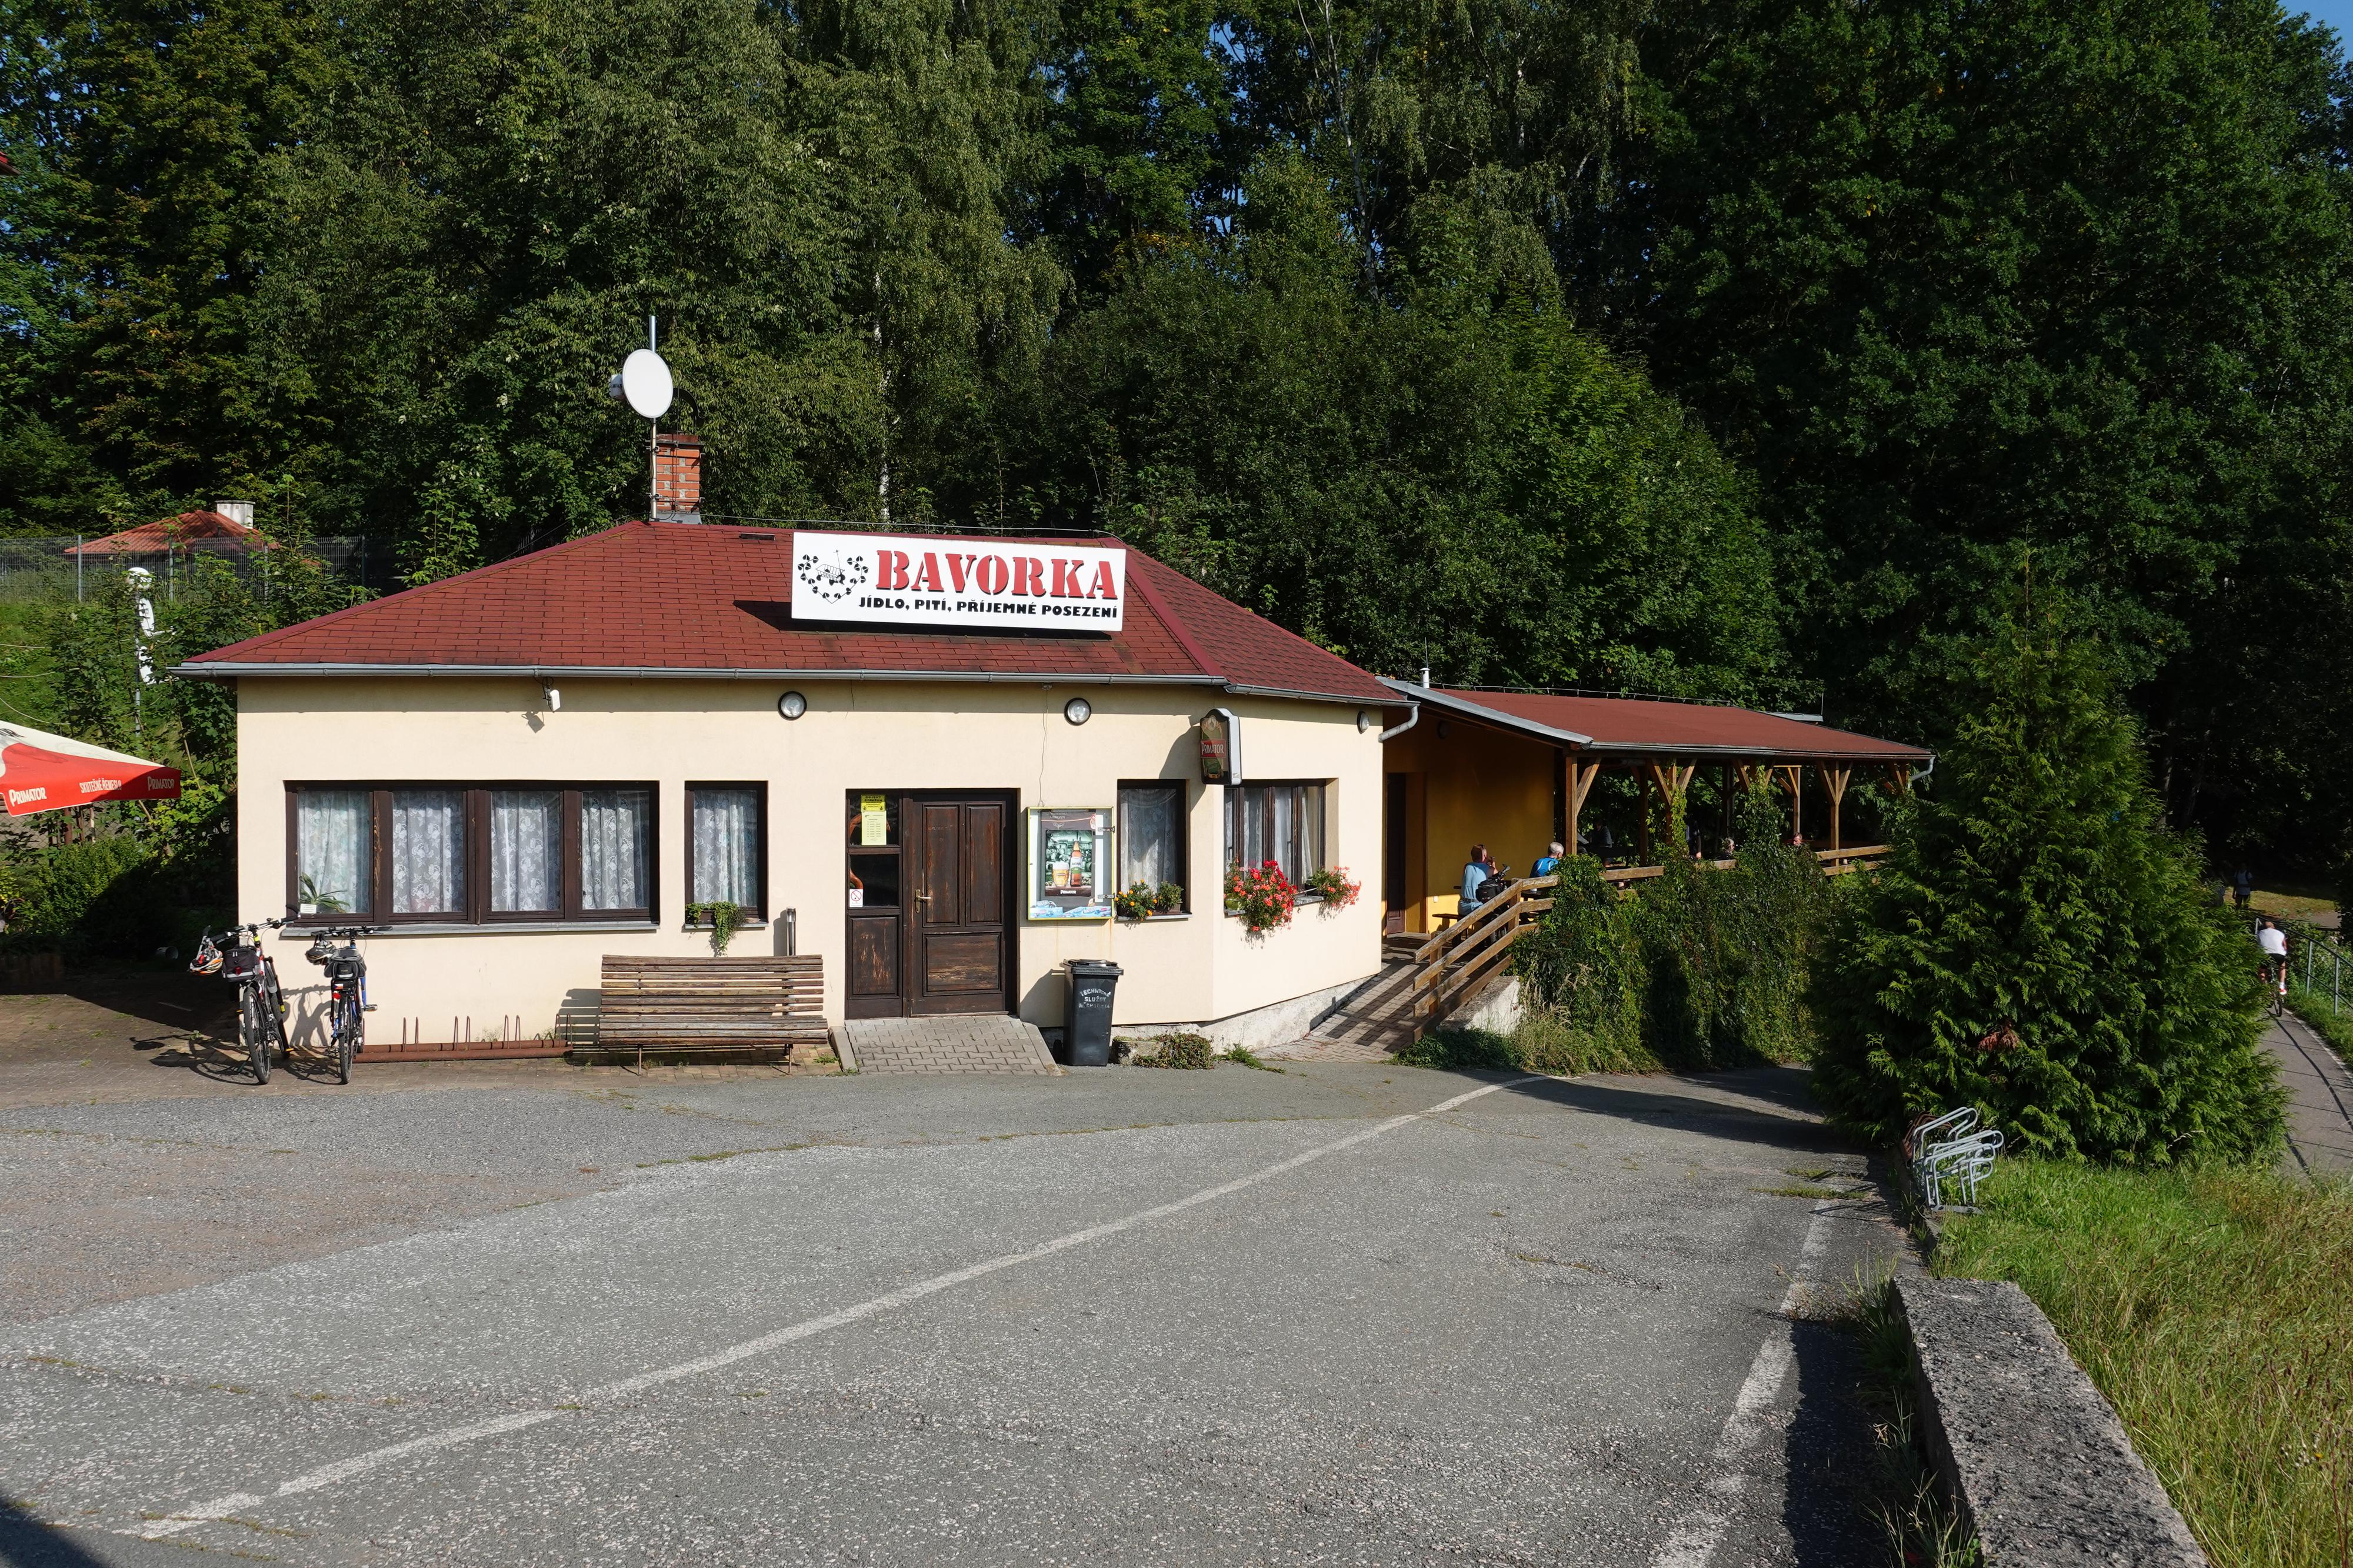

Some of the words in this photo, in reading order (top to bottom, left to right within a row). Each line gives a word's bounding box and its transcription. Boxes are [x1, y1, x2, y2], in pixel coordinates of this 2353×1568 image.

[875, 549, 1118, 600] BAVORKA
[859, 595, 909, 611] JÍDLO,
[915, 598, 952, 612] PITÍ,
[956, 599, 1036, 615] PŘÍJEMNÉ
[1041, 605, 1118, 618] POSEZENÍ
[1201, 742, 1224, 755] PRIMATOR
[79, 778, 103, 793] SKUTEČNÉ
[148, 776, 175, 791] PRIMATOR
[9, 787, 47, 806] PRIMATOR
